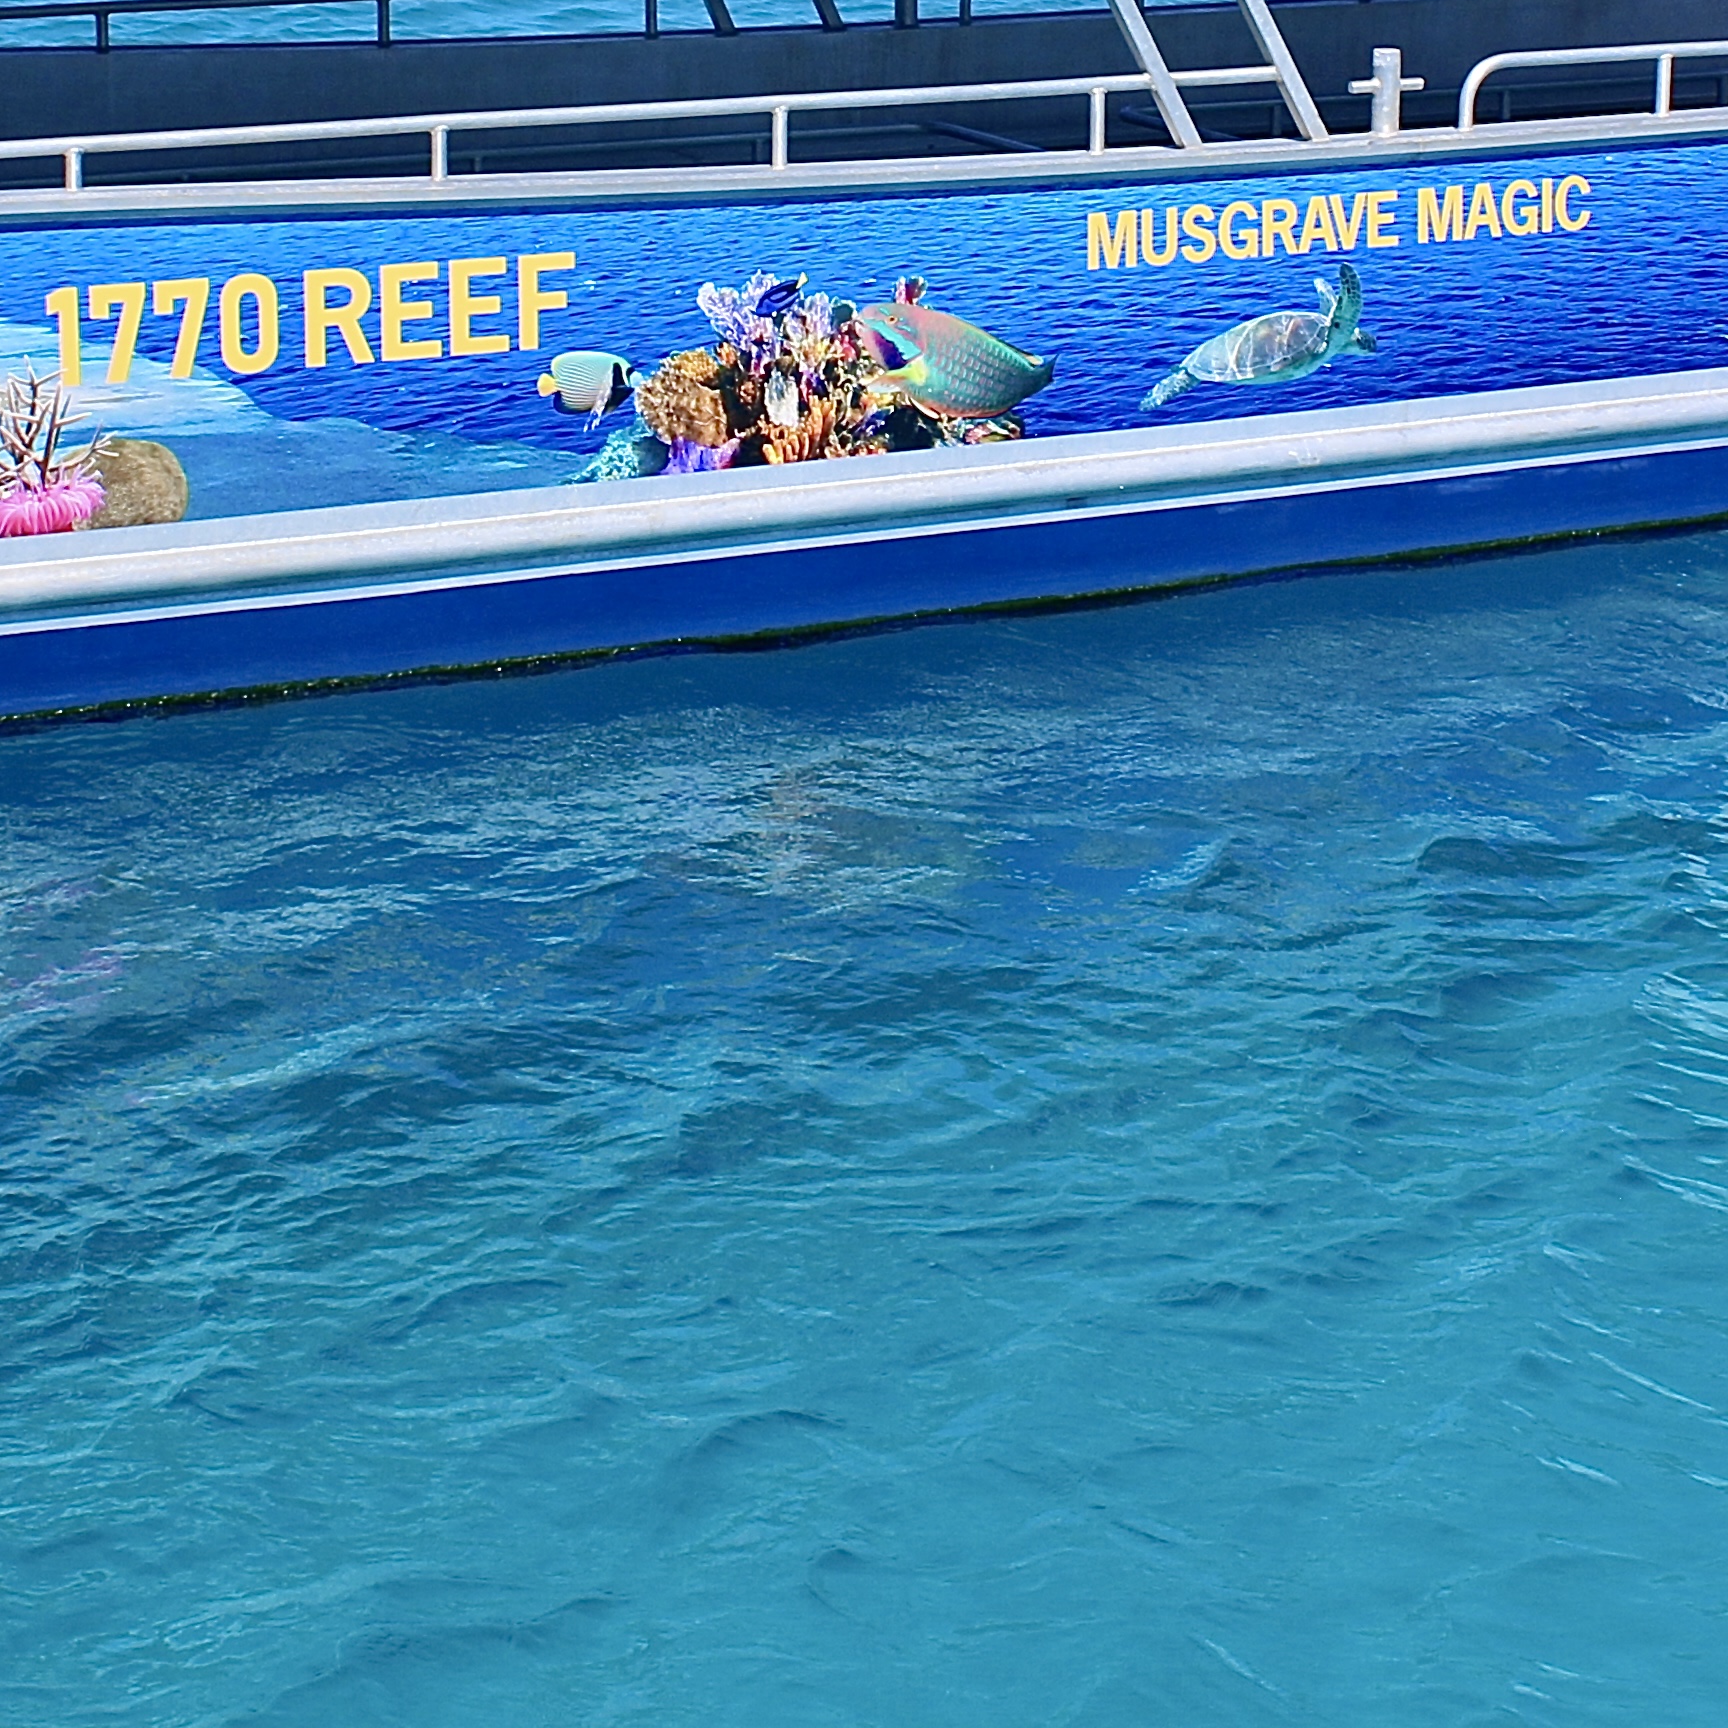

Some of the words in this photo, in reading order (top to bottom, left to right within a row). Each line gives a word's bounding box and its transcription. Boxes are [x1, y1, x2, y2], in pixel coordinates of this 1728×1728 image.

[1086, 190, 1399, 271] MUSGRAVE
[1417, 175, 1592, 244] MAGIC
[45, 272, 279, 387] 1770
[303, 251, 576, 368] REEF
